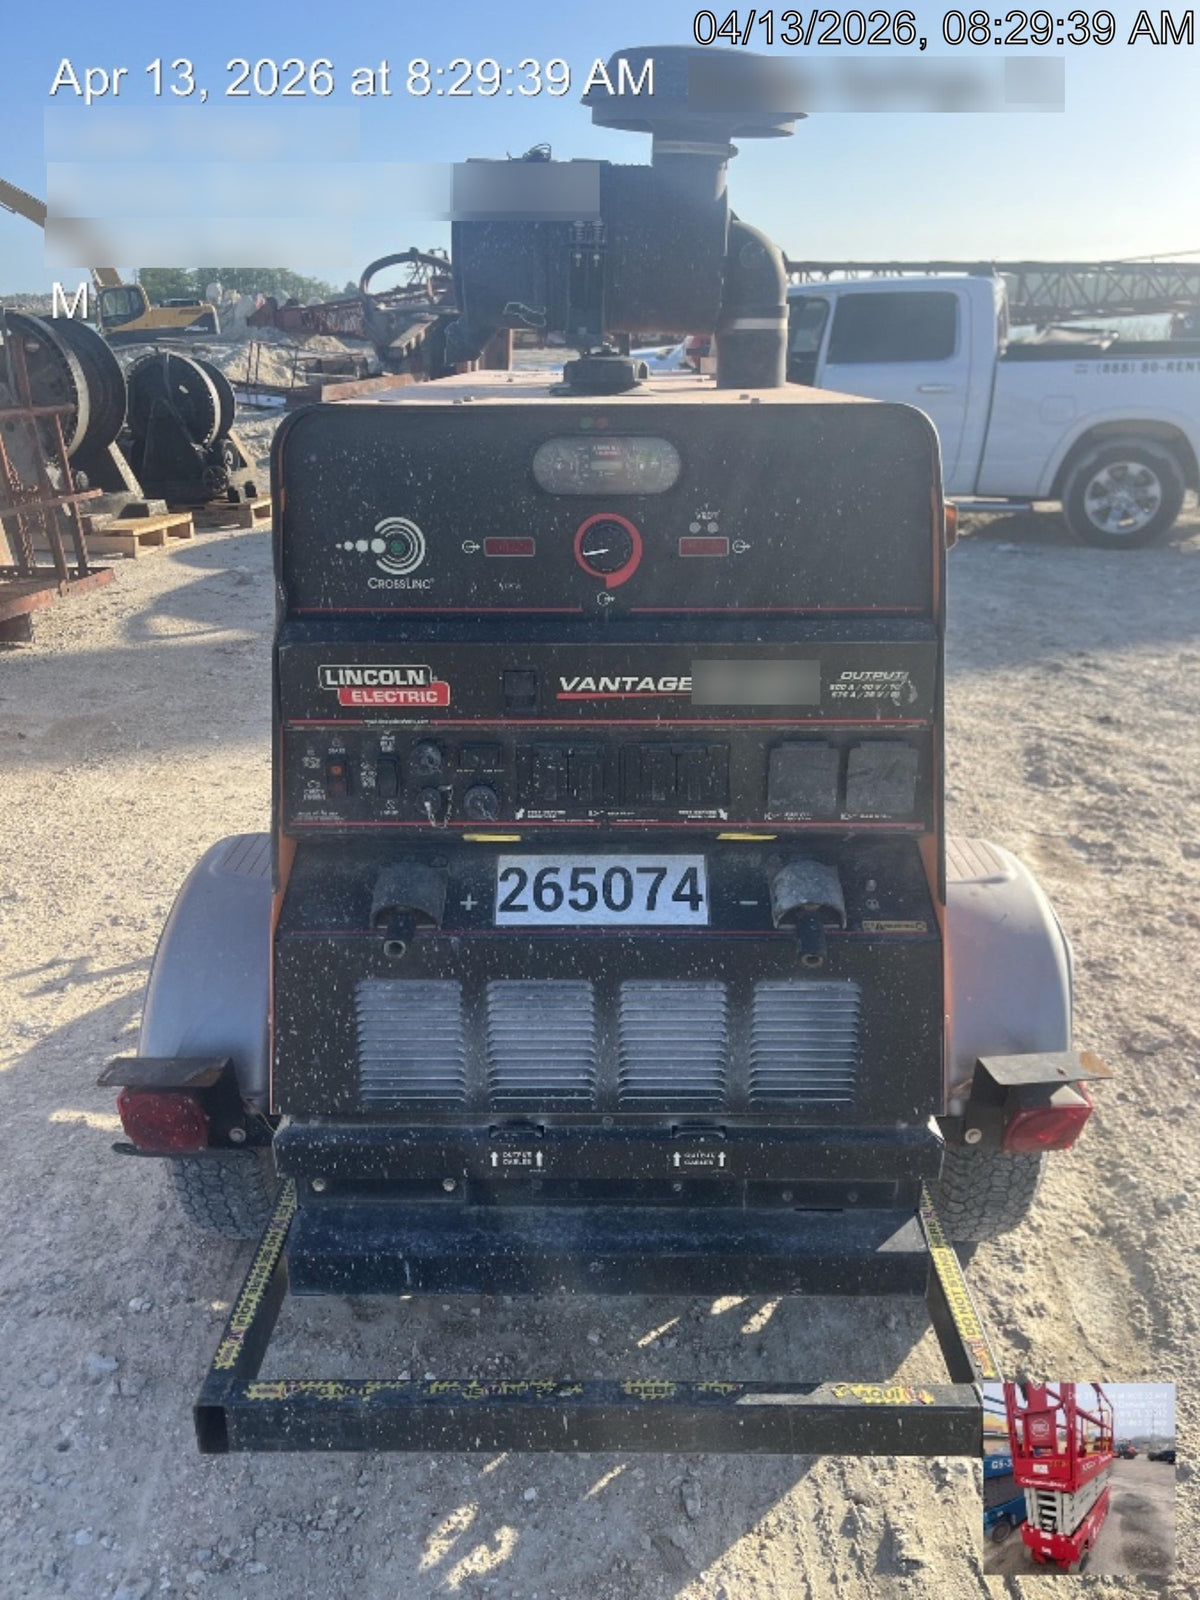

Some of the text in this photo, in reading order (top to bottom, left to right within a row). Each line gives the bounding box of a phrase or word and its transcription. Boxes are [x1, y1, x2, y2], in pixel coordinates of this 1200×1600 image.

[324, 668, 426, 686] LINCOLN
[559, 676, 693, 692] VANTAGE
[840, 671, 907, 682] OUTPUT
[351, 690, 438, 703] ELECTRIC
[498, 866, 703, 912] 265074
[952, 1289, 970, 1314] NOT
[961, 1316, 977, 1335] DO
